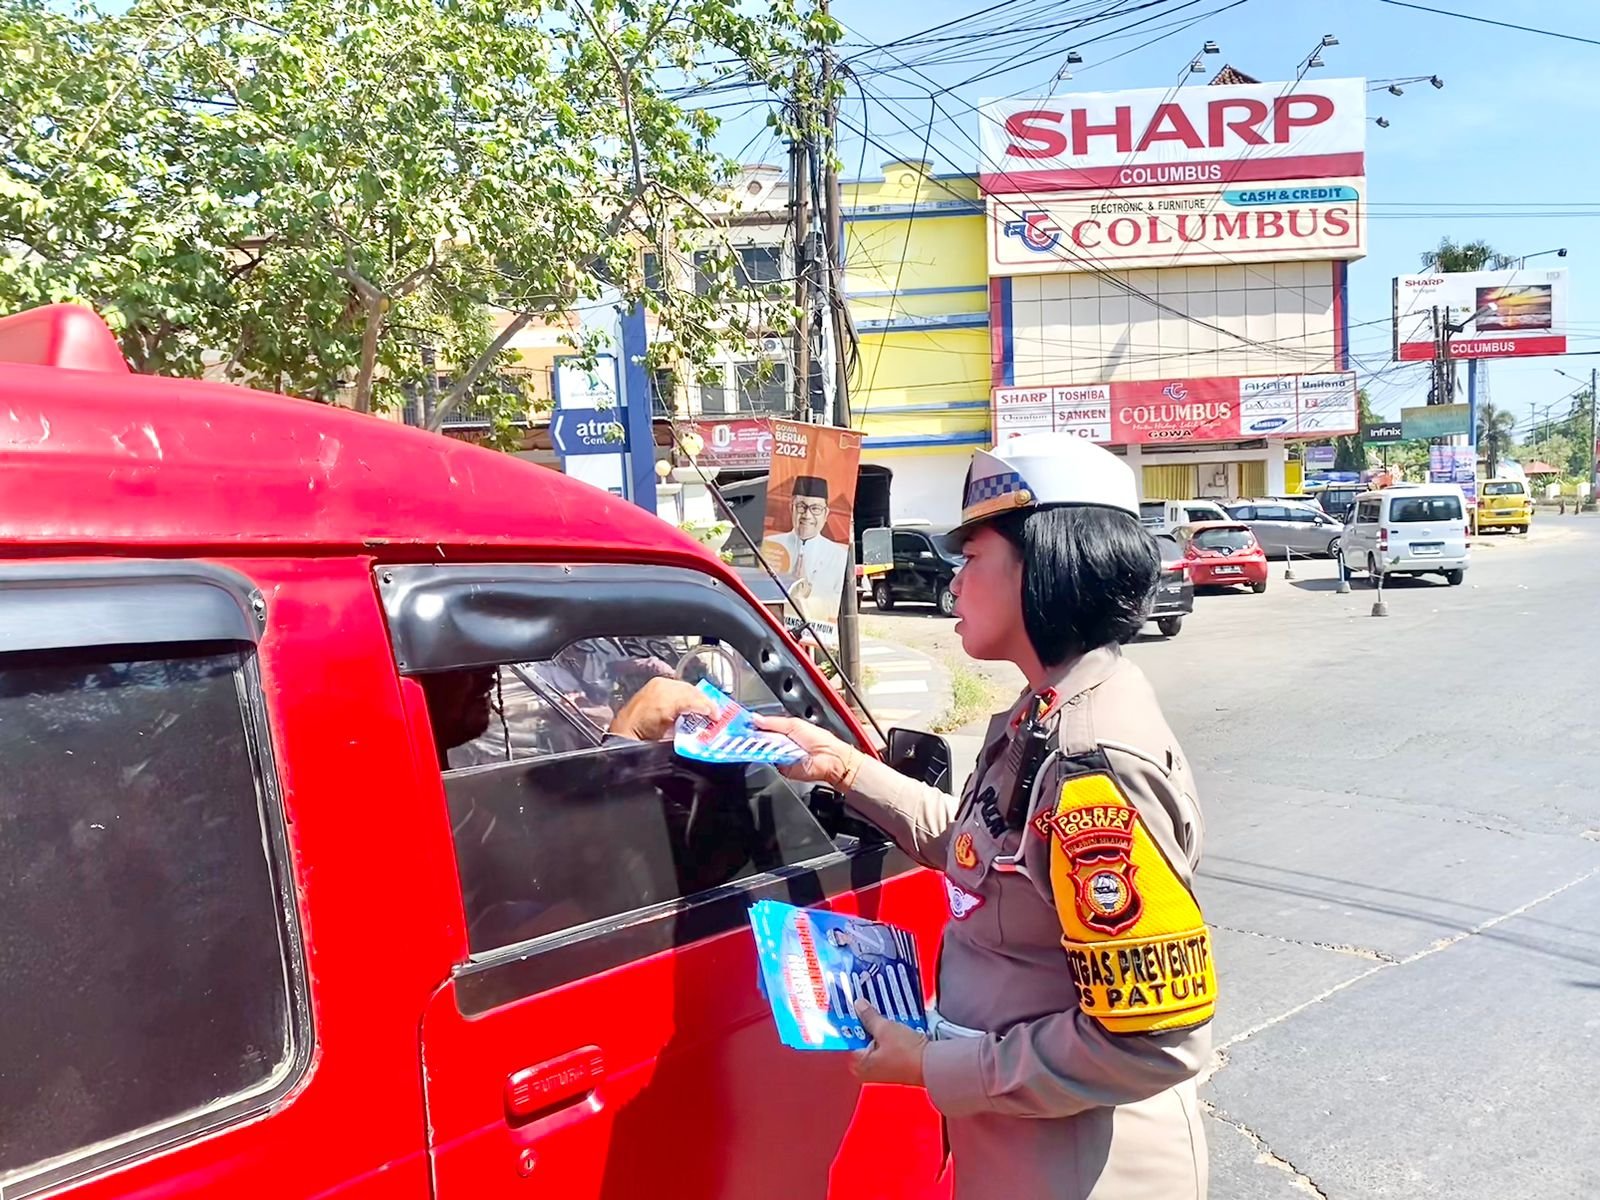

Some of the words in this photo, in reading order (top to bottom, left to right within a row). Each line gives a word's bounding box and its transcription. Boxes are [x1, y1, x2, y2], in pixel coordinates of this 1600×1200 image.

[1004, 94, 1334, 158] SHARP
[1119, 164, 1222, 185] COLUMBUS
[1239, 190, 1277, 202] CASH
[1279, 189, 1289, 200] &
[1290, 187, 1342, 200] CREDIT
[1090, 202, 1144, 214] ELECTRONIC
[1148, 200, 1154, 211] &
[1158, 198, 1206, 210] FURNITURE
[1072, 208, 1350, 249] COLUMBUS
[1404, 278, 1444, 287] SHARP
[1450, 342, 1515, 354] COLUMBUS
[1001, 393, 1048, 404] SHARP
[1059, 390, 1105, 401] TOSHIBA
[1059, 410, 1106, 421] SANKEN
[1119, 402, 1231, 425] COLUMBUS
[775, 424, 798, 433] GOWA
[1066, 428, 1100, 438] TCL
[1148, 430, 1192, 438] GOWA
[1370, 428, 1401, 437] Infinix
[775, 432, 808, 445] BERUA
[775, 443, 807, 458] 2024
[1058, 807, 1129, 829] POLRES
[1064, 817, 1124, 835] GOWA
[1117, 936, 1207, 984] PREVENTIF
[1107, 976, 1206, 1008] PATUH
